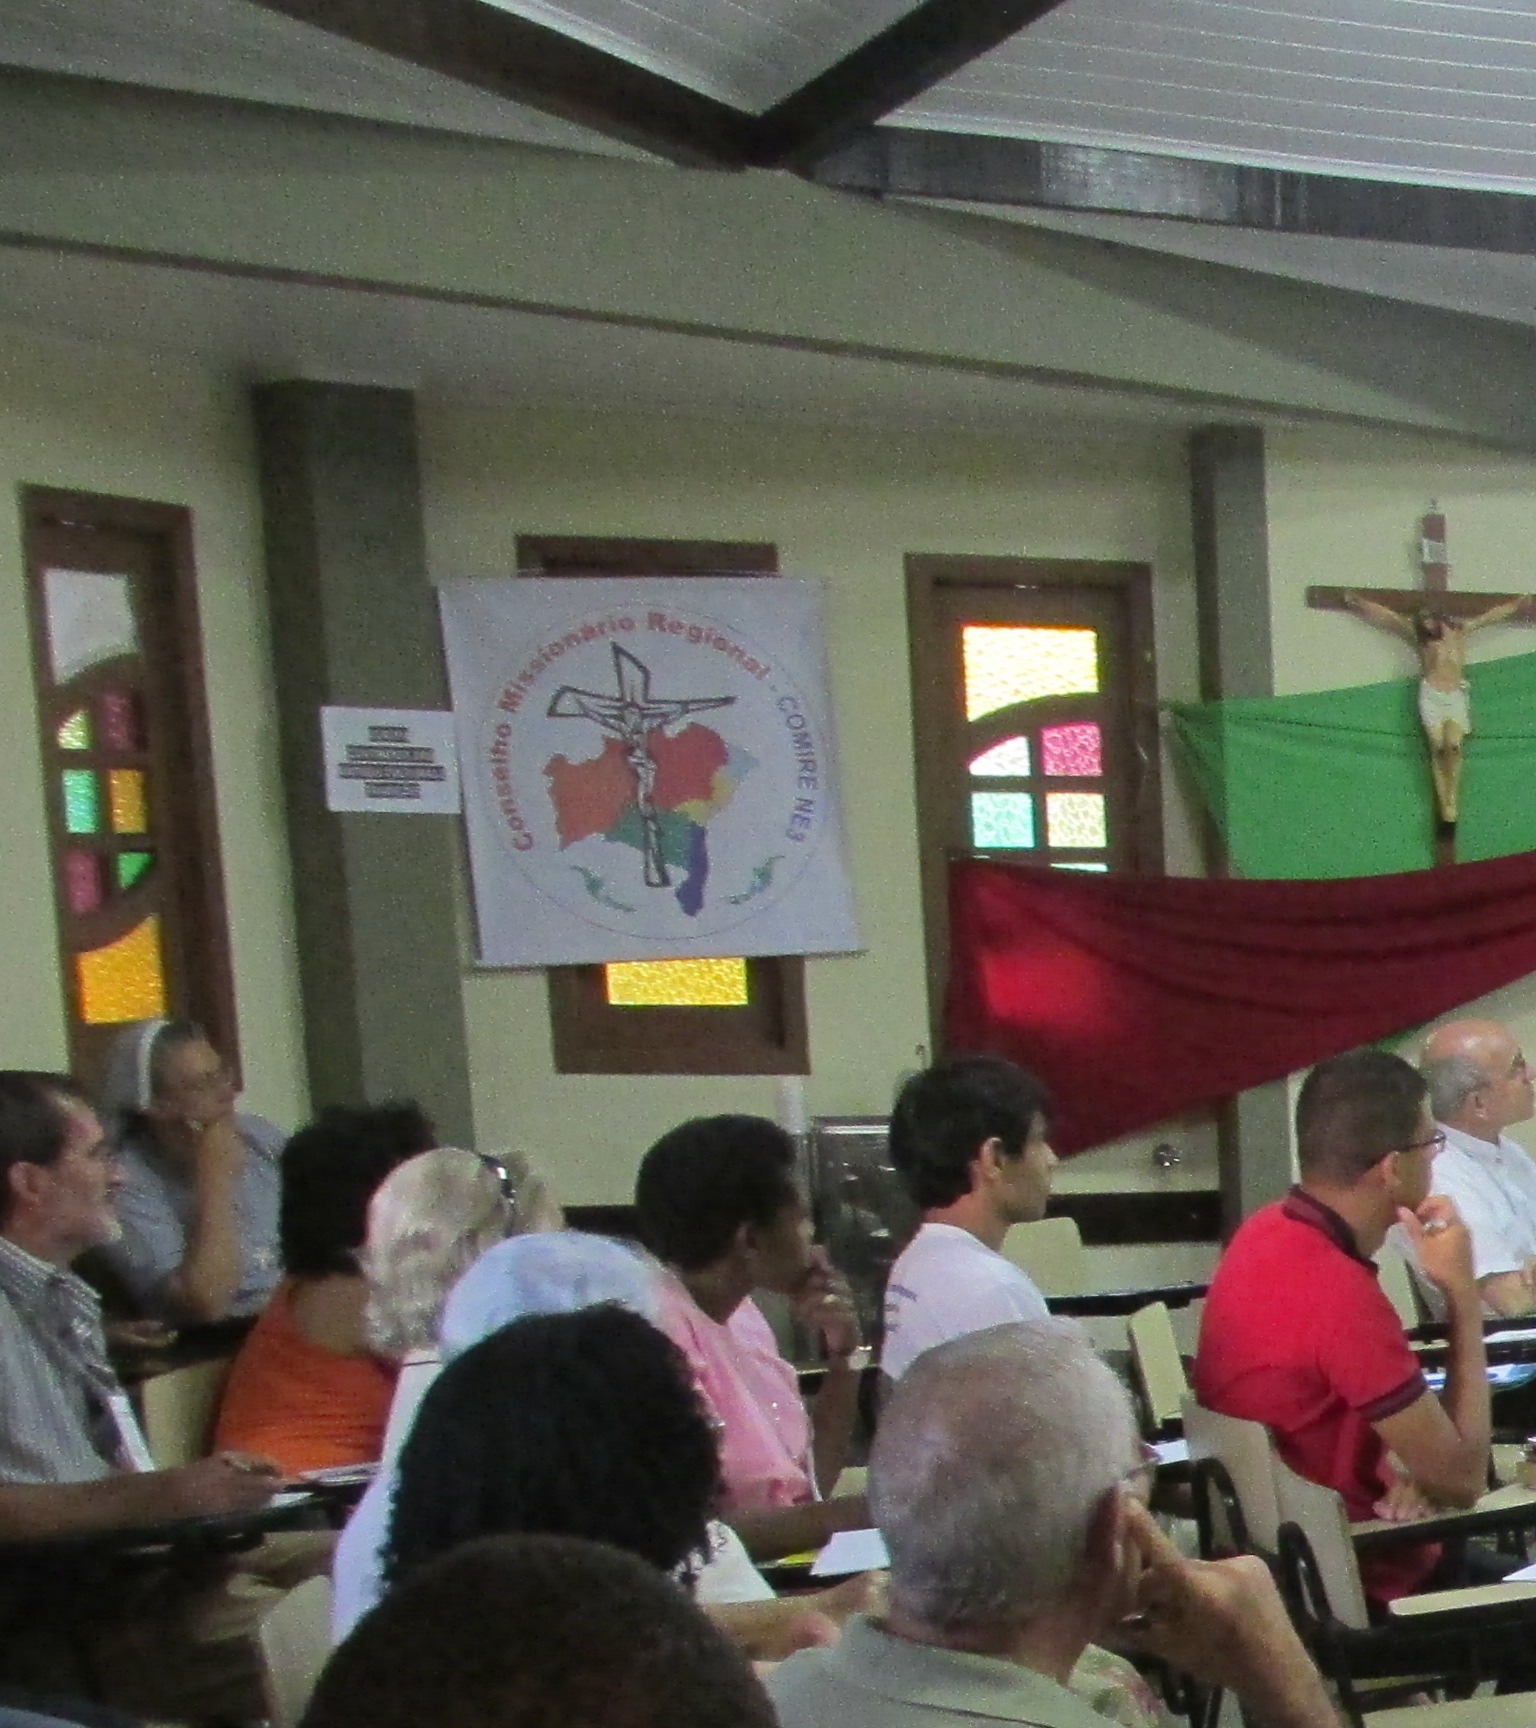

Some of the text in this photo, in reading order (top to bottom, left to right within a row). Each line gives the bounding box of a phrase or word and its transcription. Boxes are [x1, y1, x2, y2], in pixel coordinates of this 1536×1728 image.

[499, 616, 635, 713] Missionário
[647, 612, 771, 673] Regional
[490, 723, 534, 851] Conselho
